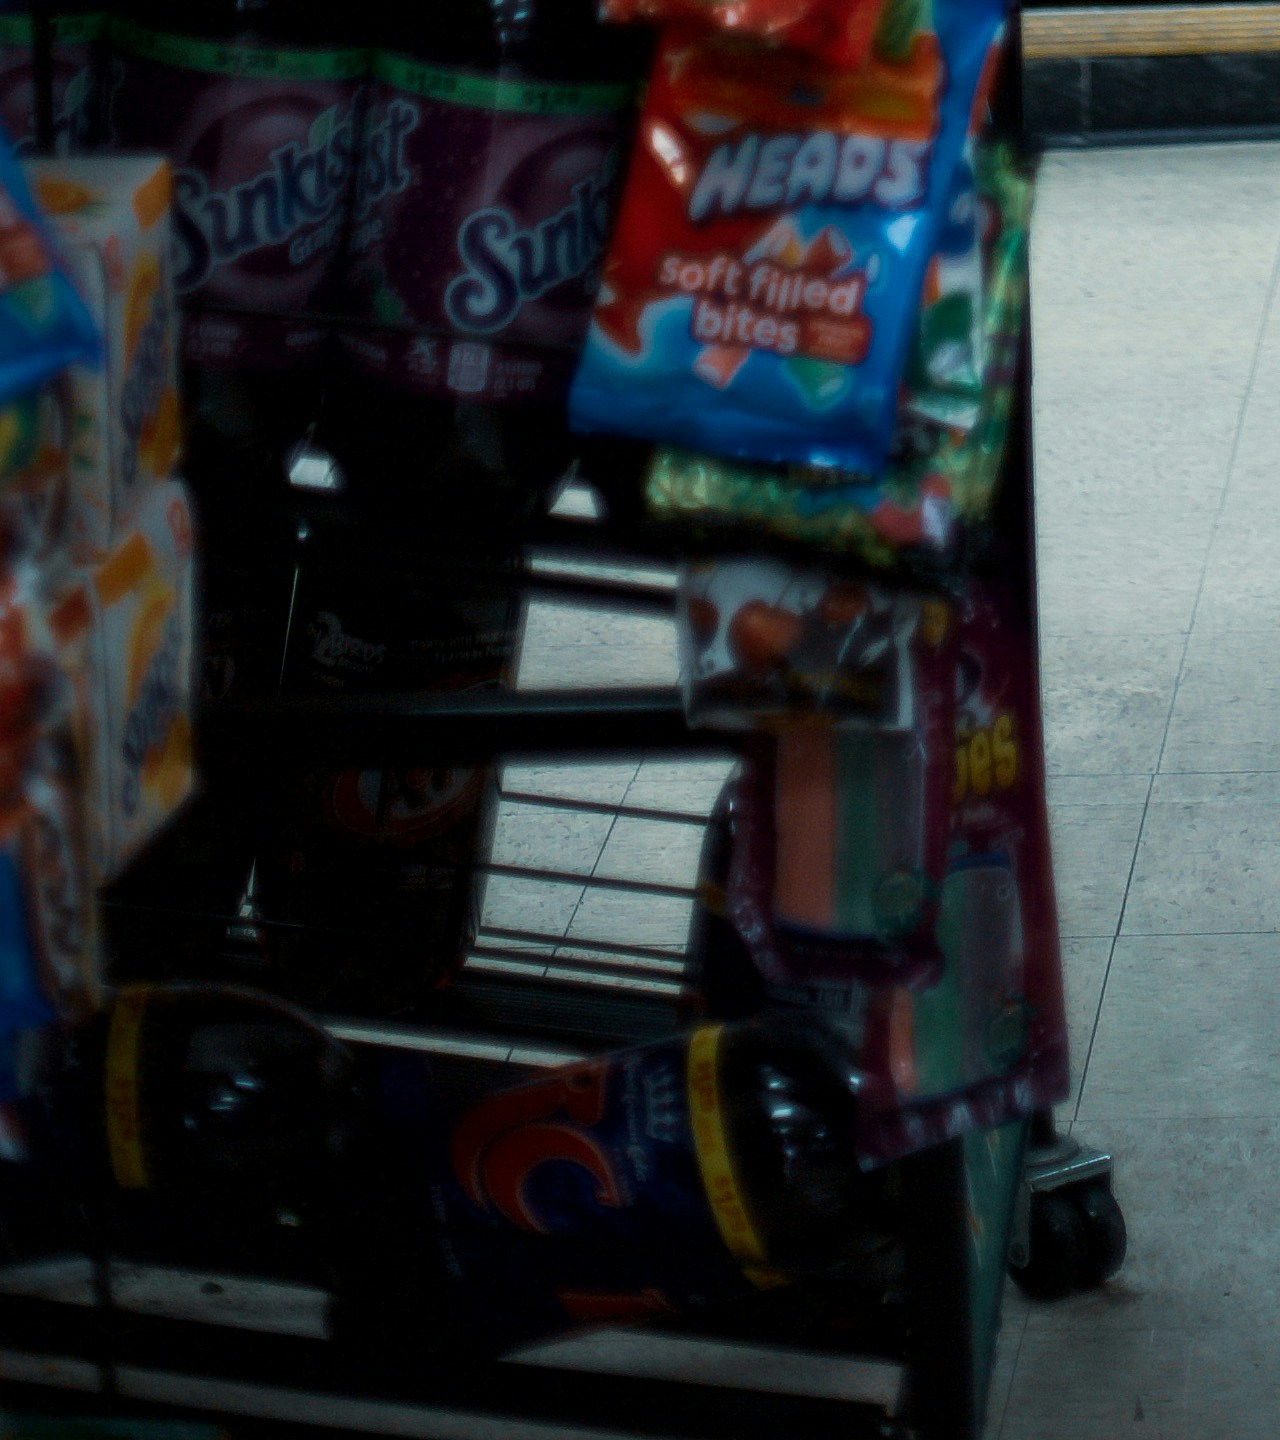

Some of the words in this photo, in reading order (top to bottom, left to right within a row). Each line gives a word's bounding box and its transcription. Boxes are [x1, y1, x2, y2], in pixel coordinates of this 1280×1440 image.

[688, 128, 930, 224] HEADS
[660, 254, 742, 293] soft
[749, 261, 861, 316] filled
[696, 300, 801, 356] bites
